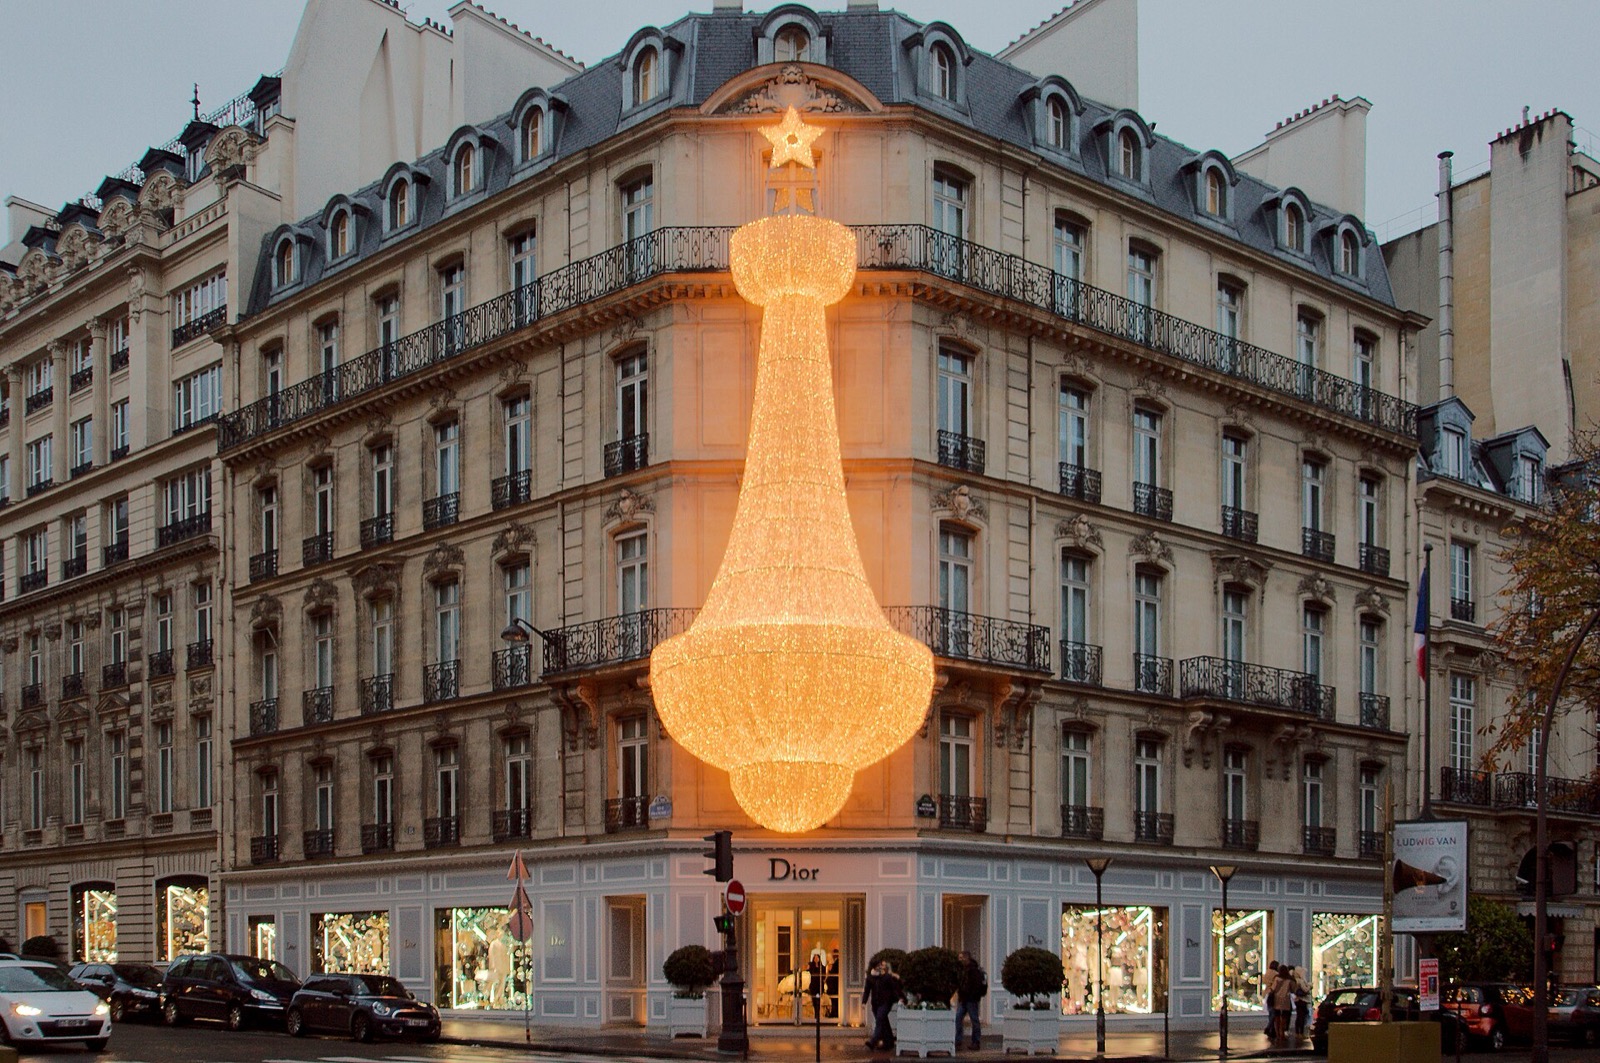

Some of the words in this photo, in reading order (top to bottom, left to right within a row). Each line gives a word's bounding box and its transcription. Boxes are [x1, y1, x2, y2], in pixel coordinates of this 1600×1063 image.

[1396, 838, 1435, 847] LUDWIG
[1436, 837, 1457, 845] VAN
[768, 858, 819, 881] Dior
